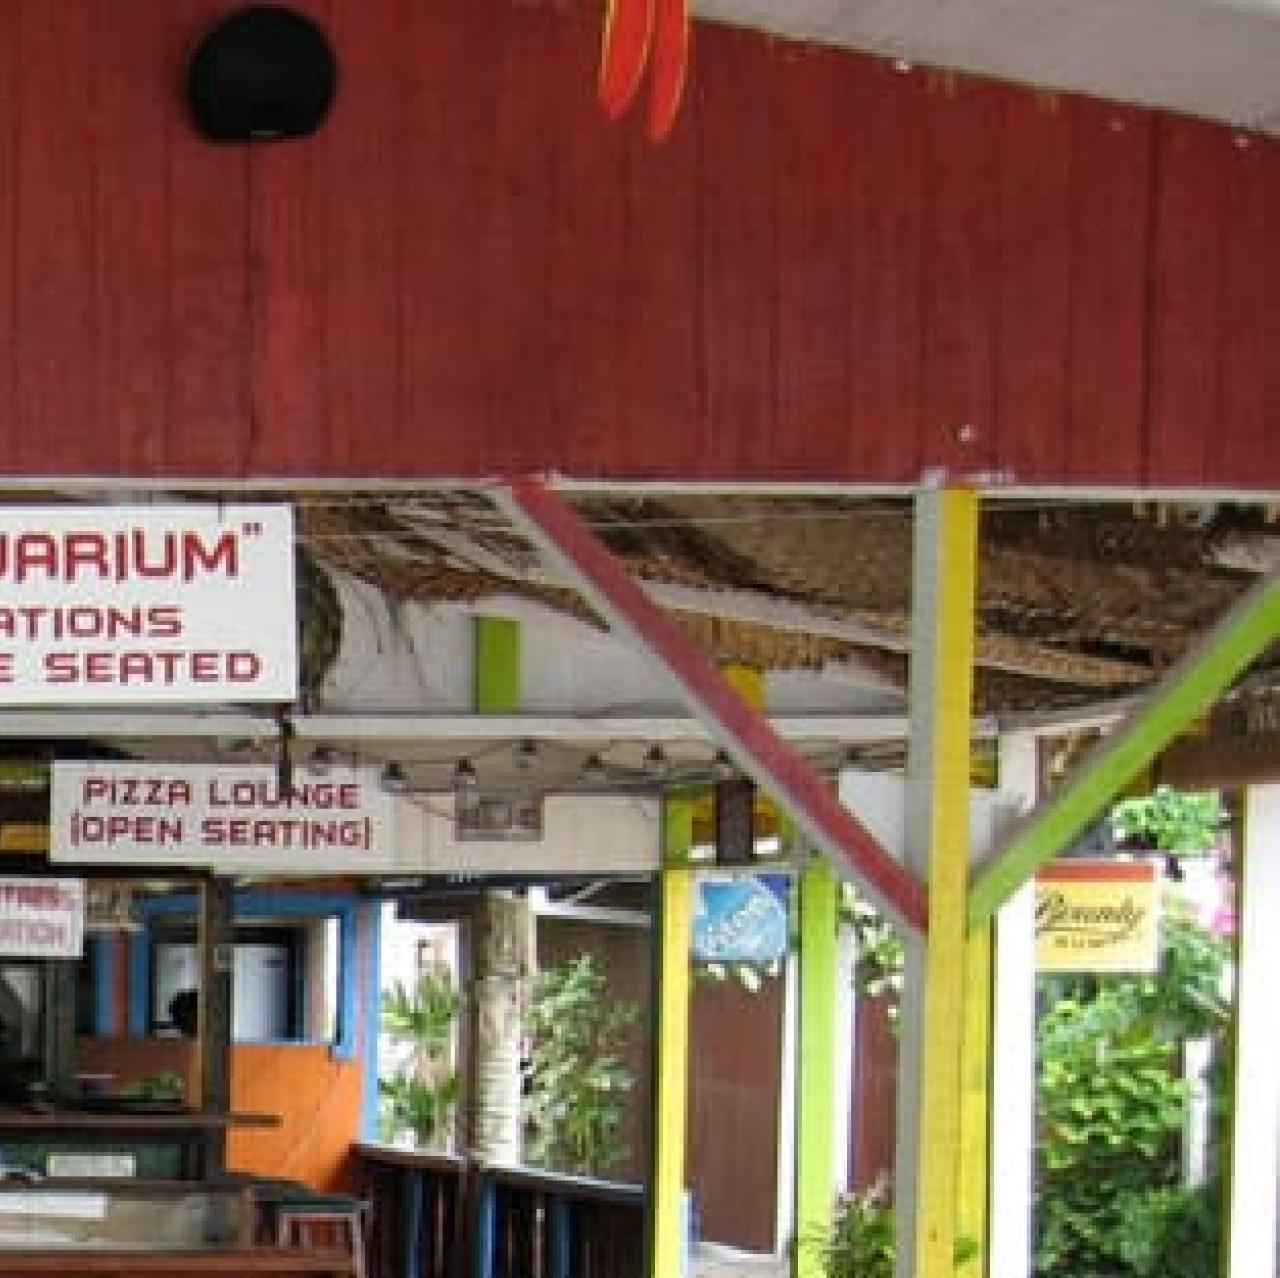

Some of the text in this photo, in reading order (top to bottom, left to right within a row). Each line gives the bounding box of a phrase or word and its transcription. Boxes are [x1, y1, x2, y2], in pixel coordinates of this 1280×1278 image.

[46, 651, 262, 686] SEATED
[82, 778, 362, 810] PIZZA LOUNGE
[70, 811, 371, 851] (OPEN SEATING)
